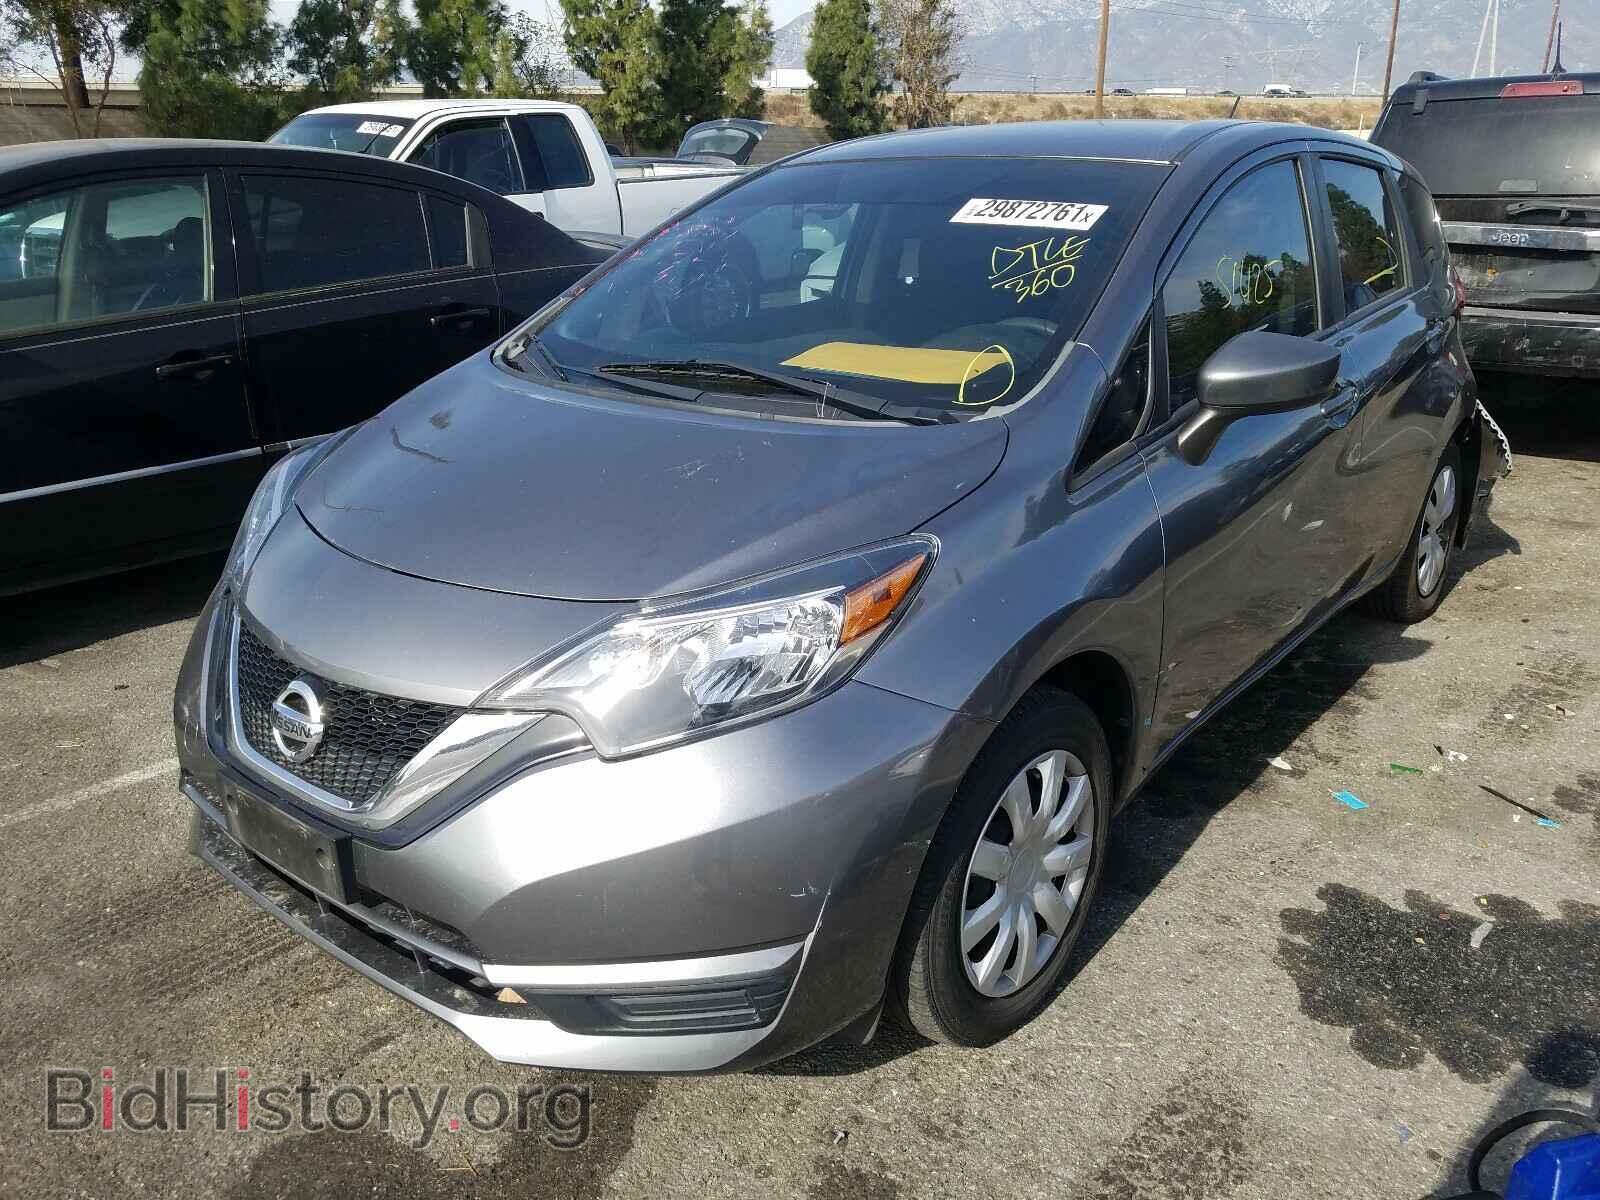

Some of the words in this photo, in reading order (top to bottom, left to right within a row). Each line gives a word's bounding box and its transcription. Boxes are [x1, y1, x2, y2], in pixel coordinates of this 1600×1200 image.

[1490, 229, 1529, 247] Jeep
[1004, 264, 1076, 304] 360
[271, 708, 315, 739] NISSAN
